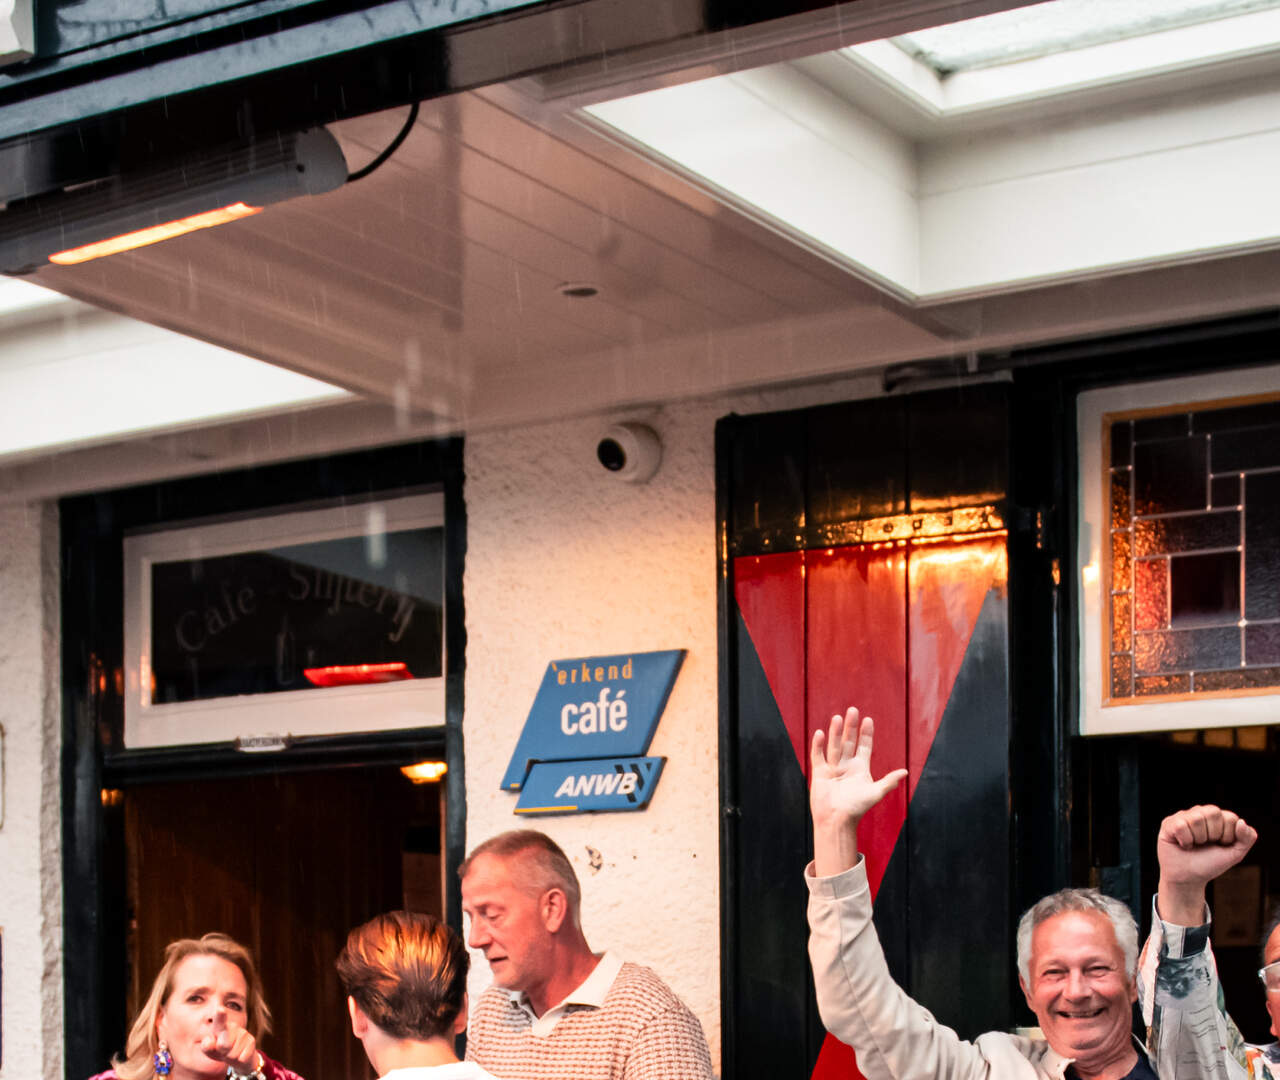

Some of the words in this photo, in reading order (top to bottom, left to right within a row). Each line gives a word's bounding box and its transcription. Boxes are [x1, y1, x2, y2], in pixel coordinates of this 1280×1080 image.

[557, 658, 634, 685] erkend
[560, 687, 629, 736] café
[554, 772, 638, 798] ANWB
